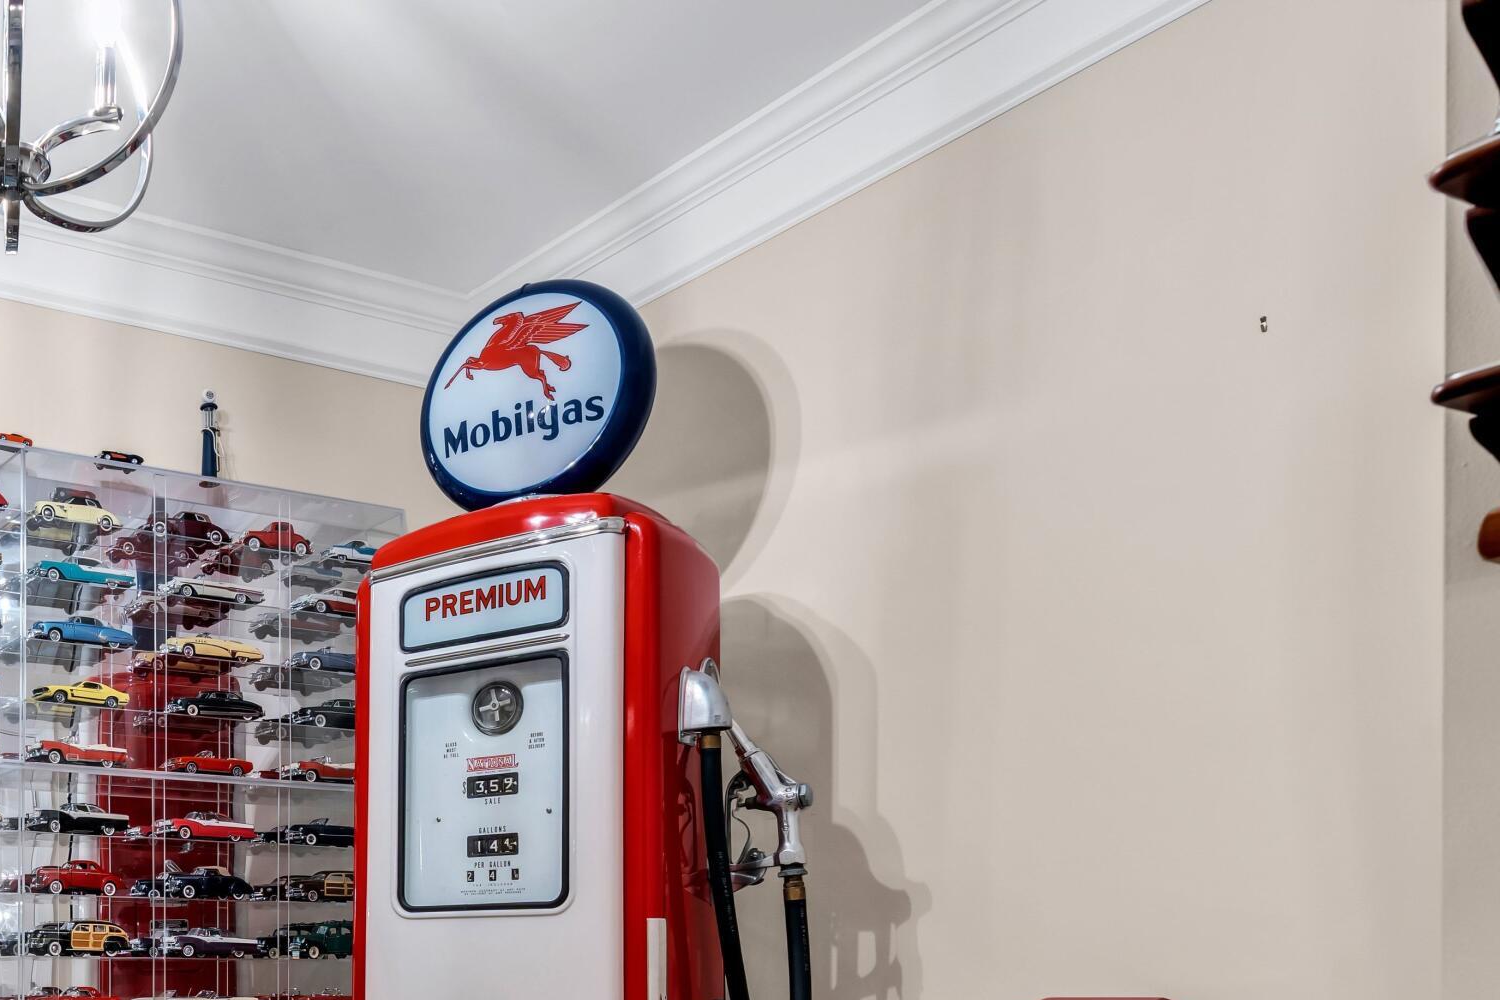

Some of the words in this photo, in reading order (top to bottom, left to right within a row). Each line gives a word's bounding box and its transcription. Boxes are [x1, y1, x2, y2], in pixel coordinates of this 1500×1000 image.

[444, 395, 605, 459] Mobilgas
[425, 575, 547, 622] PREMIUM
[484, 797, 501, 805] SALE
[478, 825, 507, 834] GALLONS
[489, 860, 511, 868] GALLON
